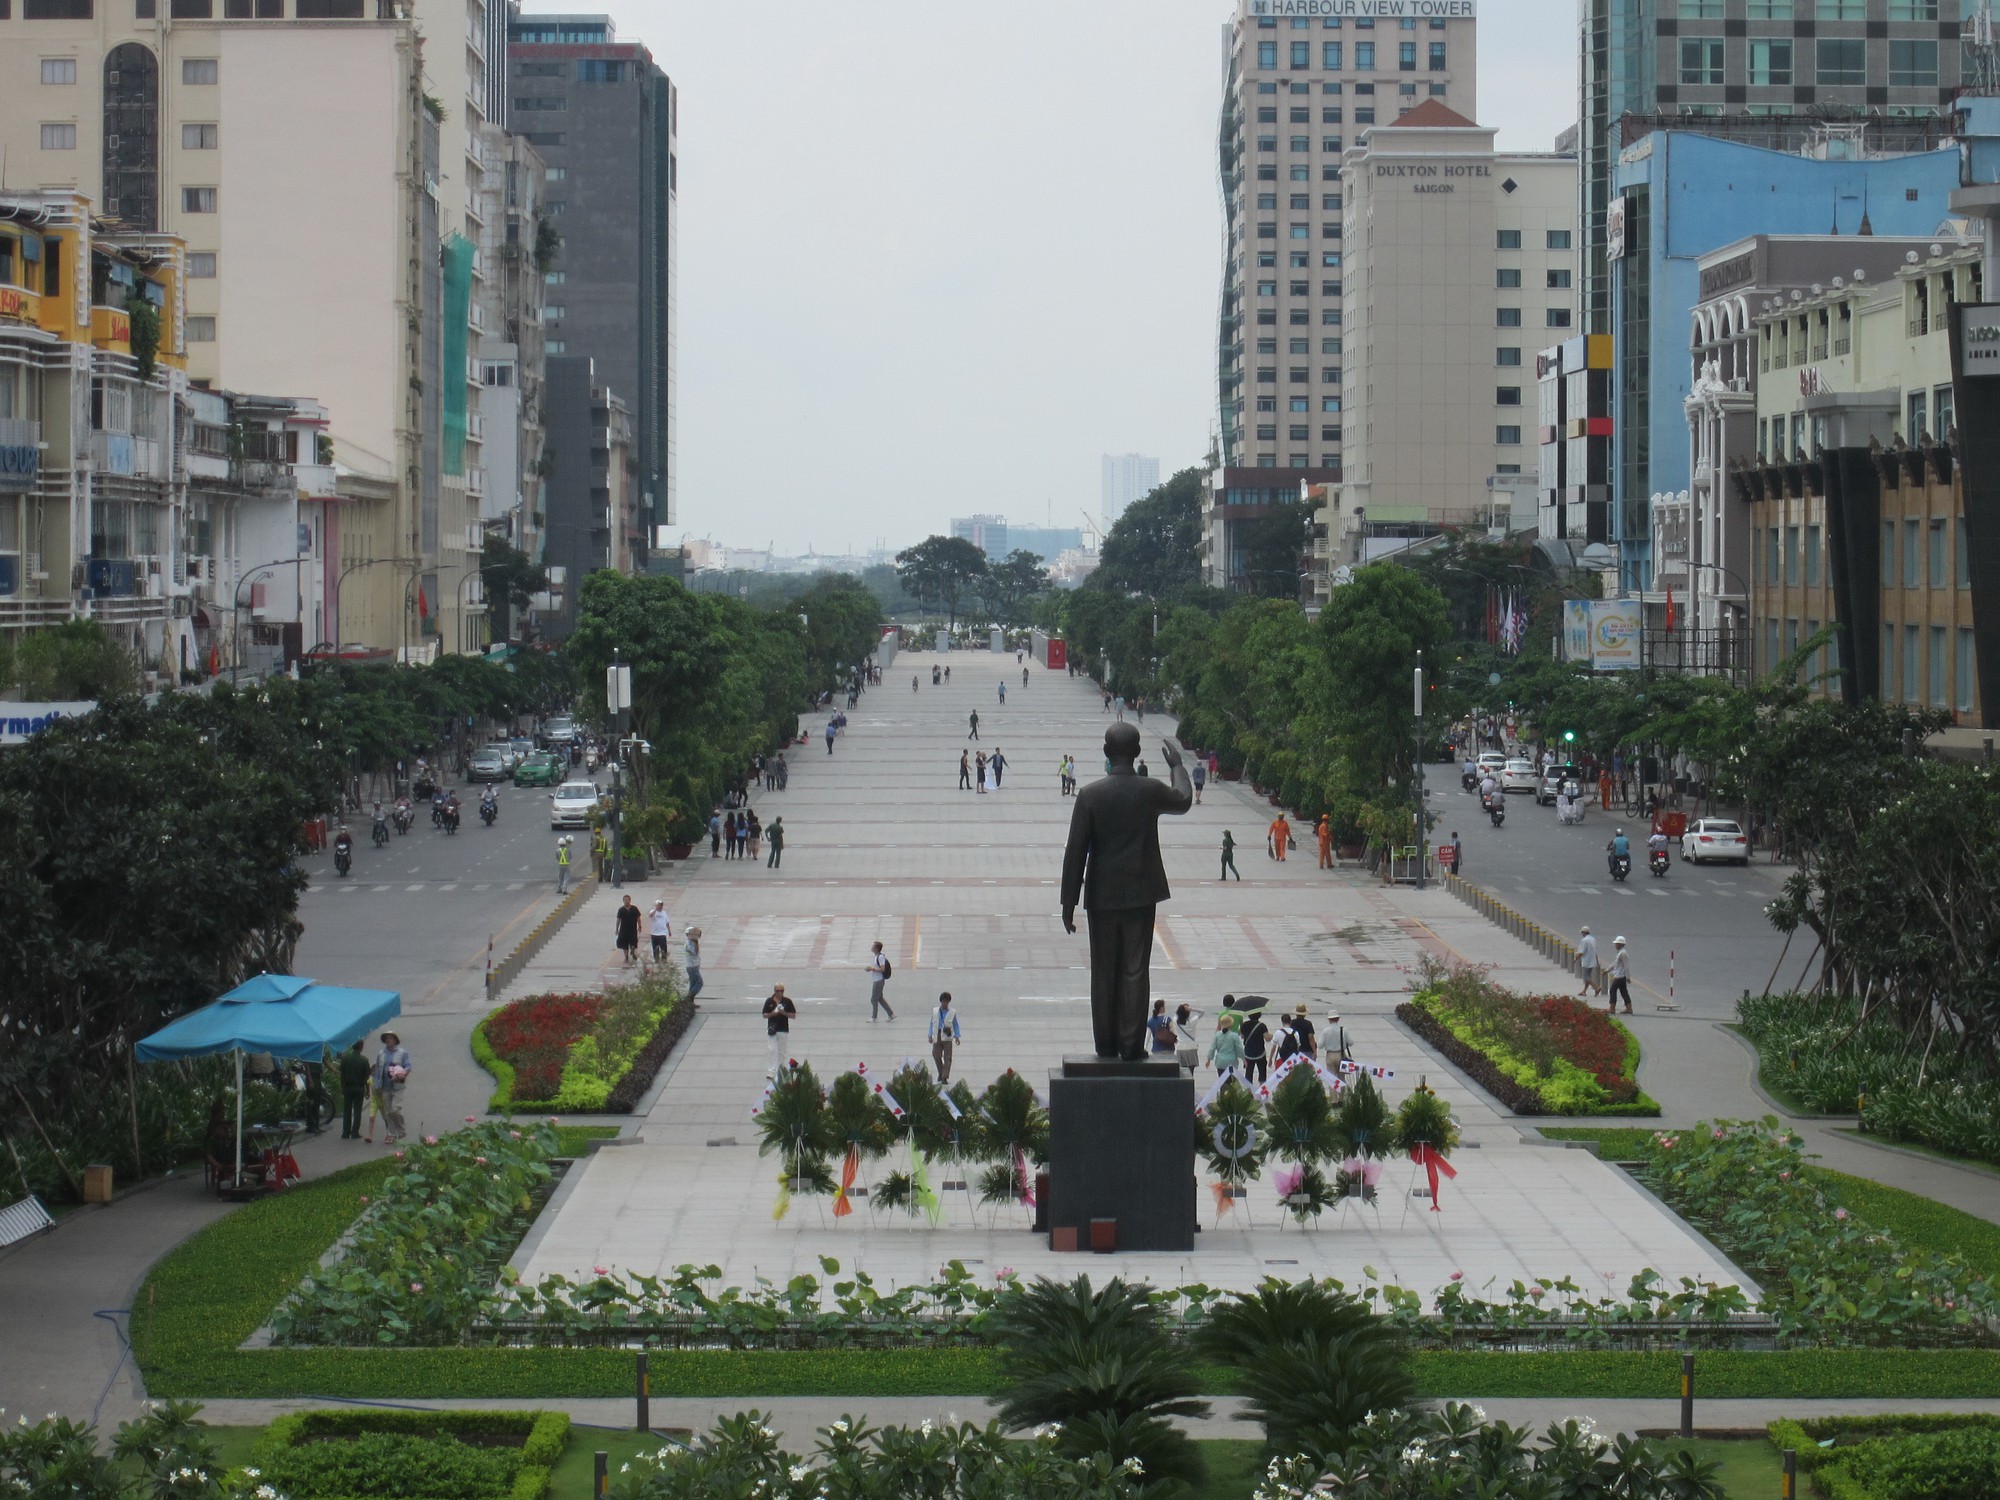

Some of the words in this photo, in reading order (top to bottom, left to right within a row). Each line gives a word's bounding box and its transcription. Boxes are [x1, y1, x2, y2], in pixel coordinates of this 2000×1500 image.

[1272, 1, 1356, 15] HARBOUR
[1362, 1, 1406, 15] VIEW
[1411, 1, 1473, 15] TOWER
[1376, 165, 1438, 177] DUXTON
[1444, 165, 1492, 177] HOTEL
[1413, 184, 1455, 193] SAIGON
